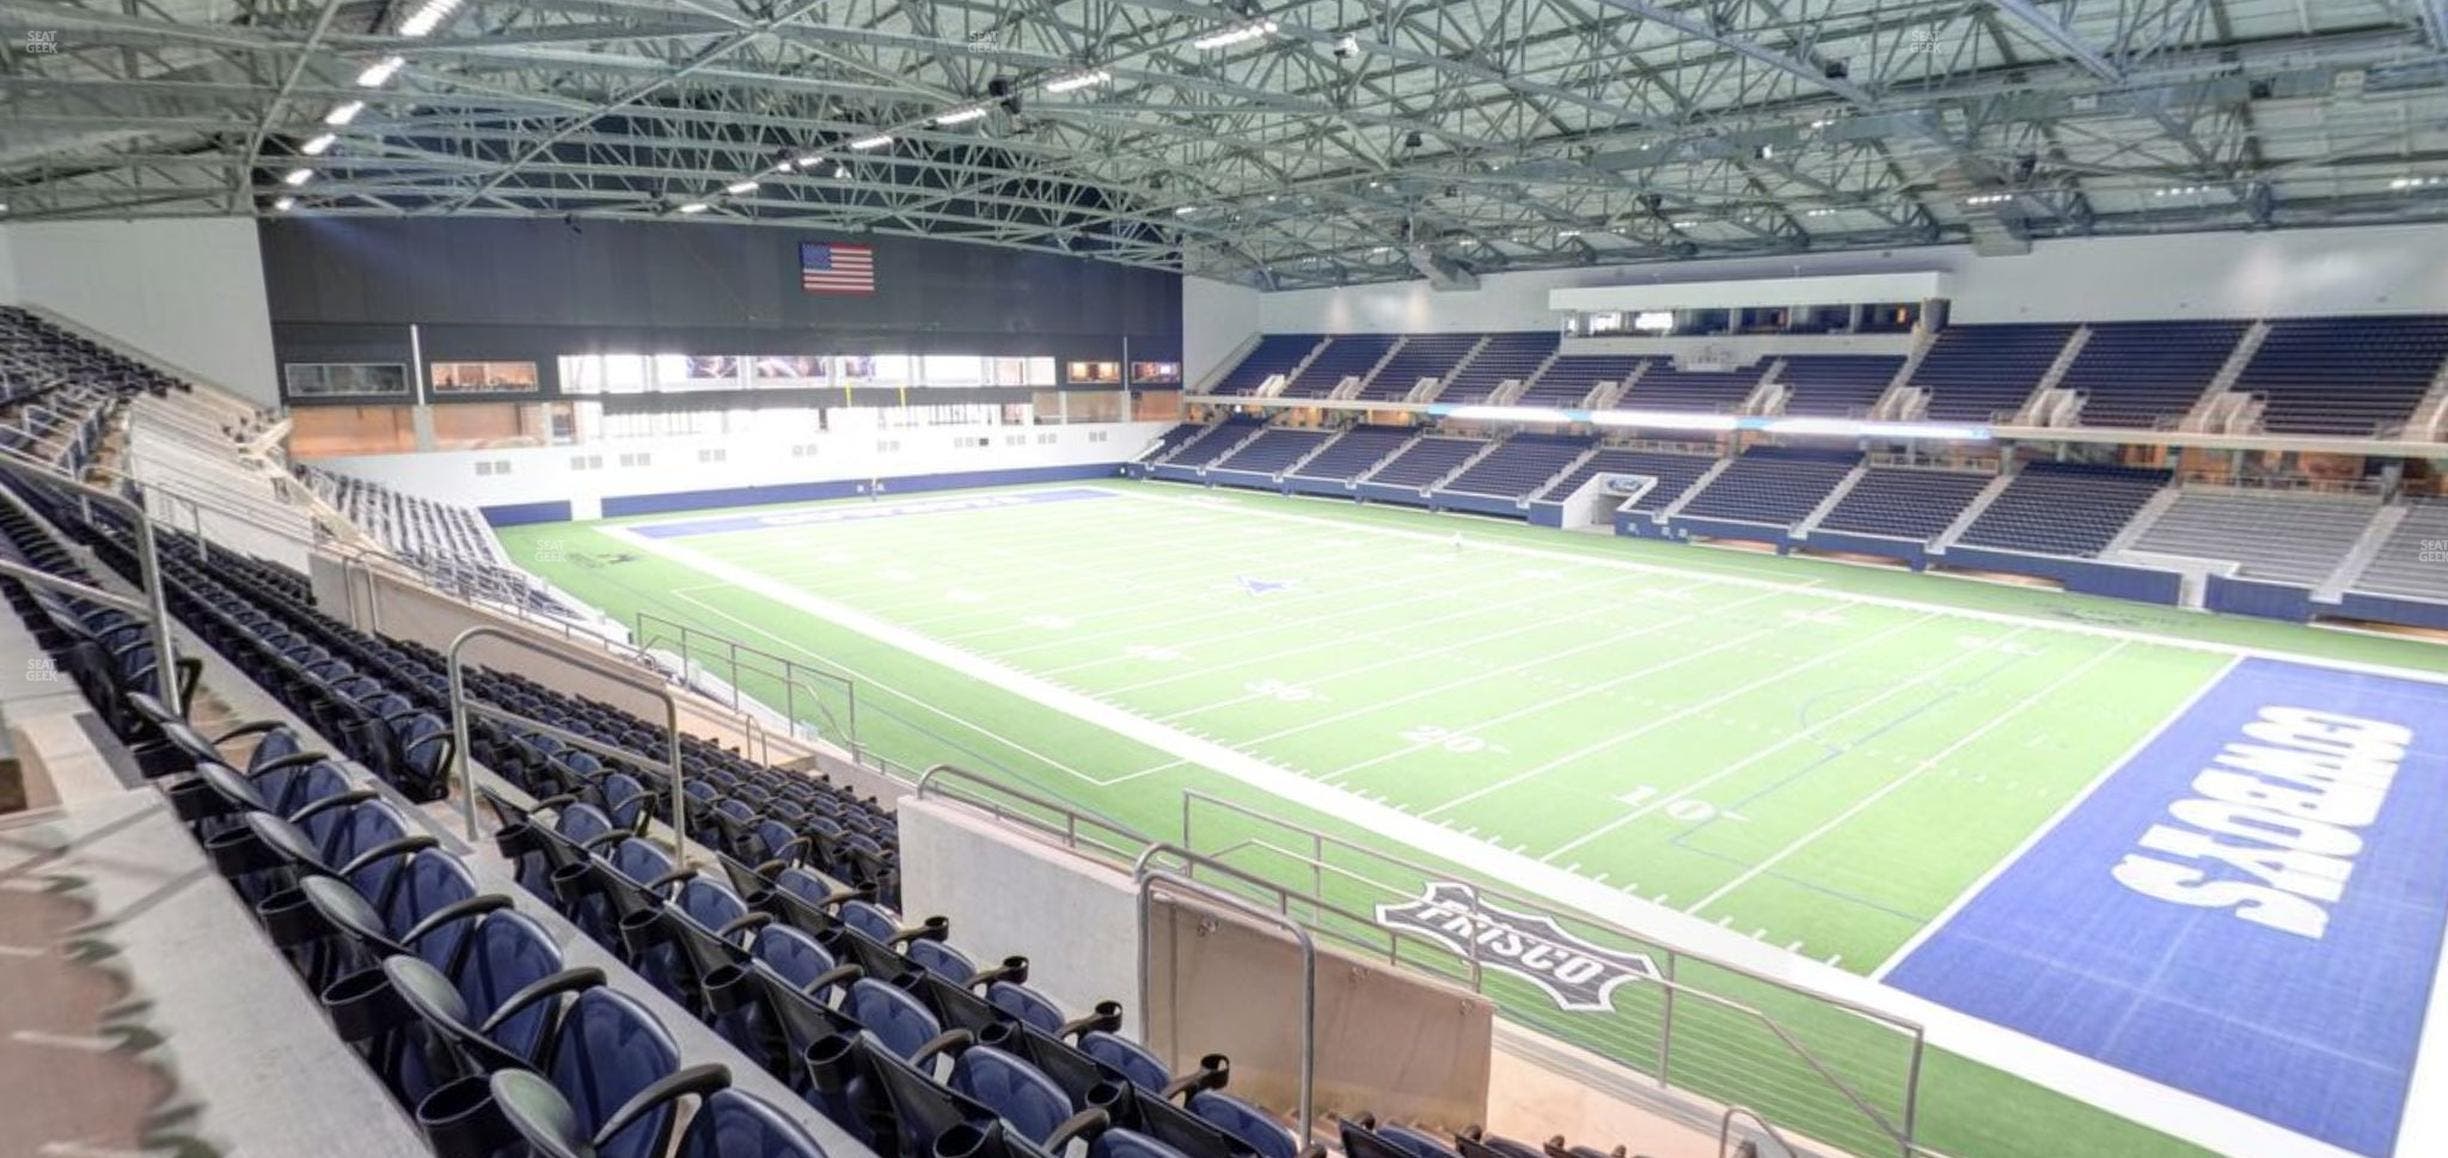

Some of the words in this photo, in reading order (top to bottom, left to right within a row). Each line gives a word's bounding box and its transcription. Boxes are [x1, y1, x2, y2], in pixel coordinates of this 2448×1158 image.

[1615, 784, 1717, 821] 10
[2110, 705, 2414, 939] COWBOYS
[1416, 900, 1604, 985] FRISCO
